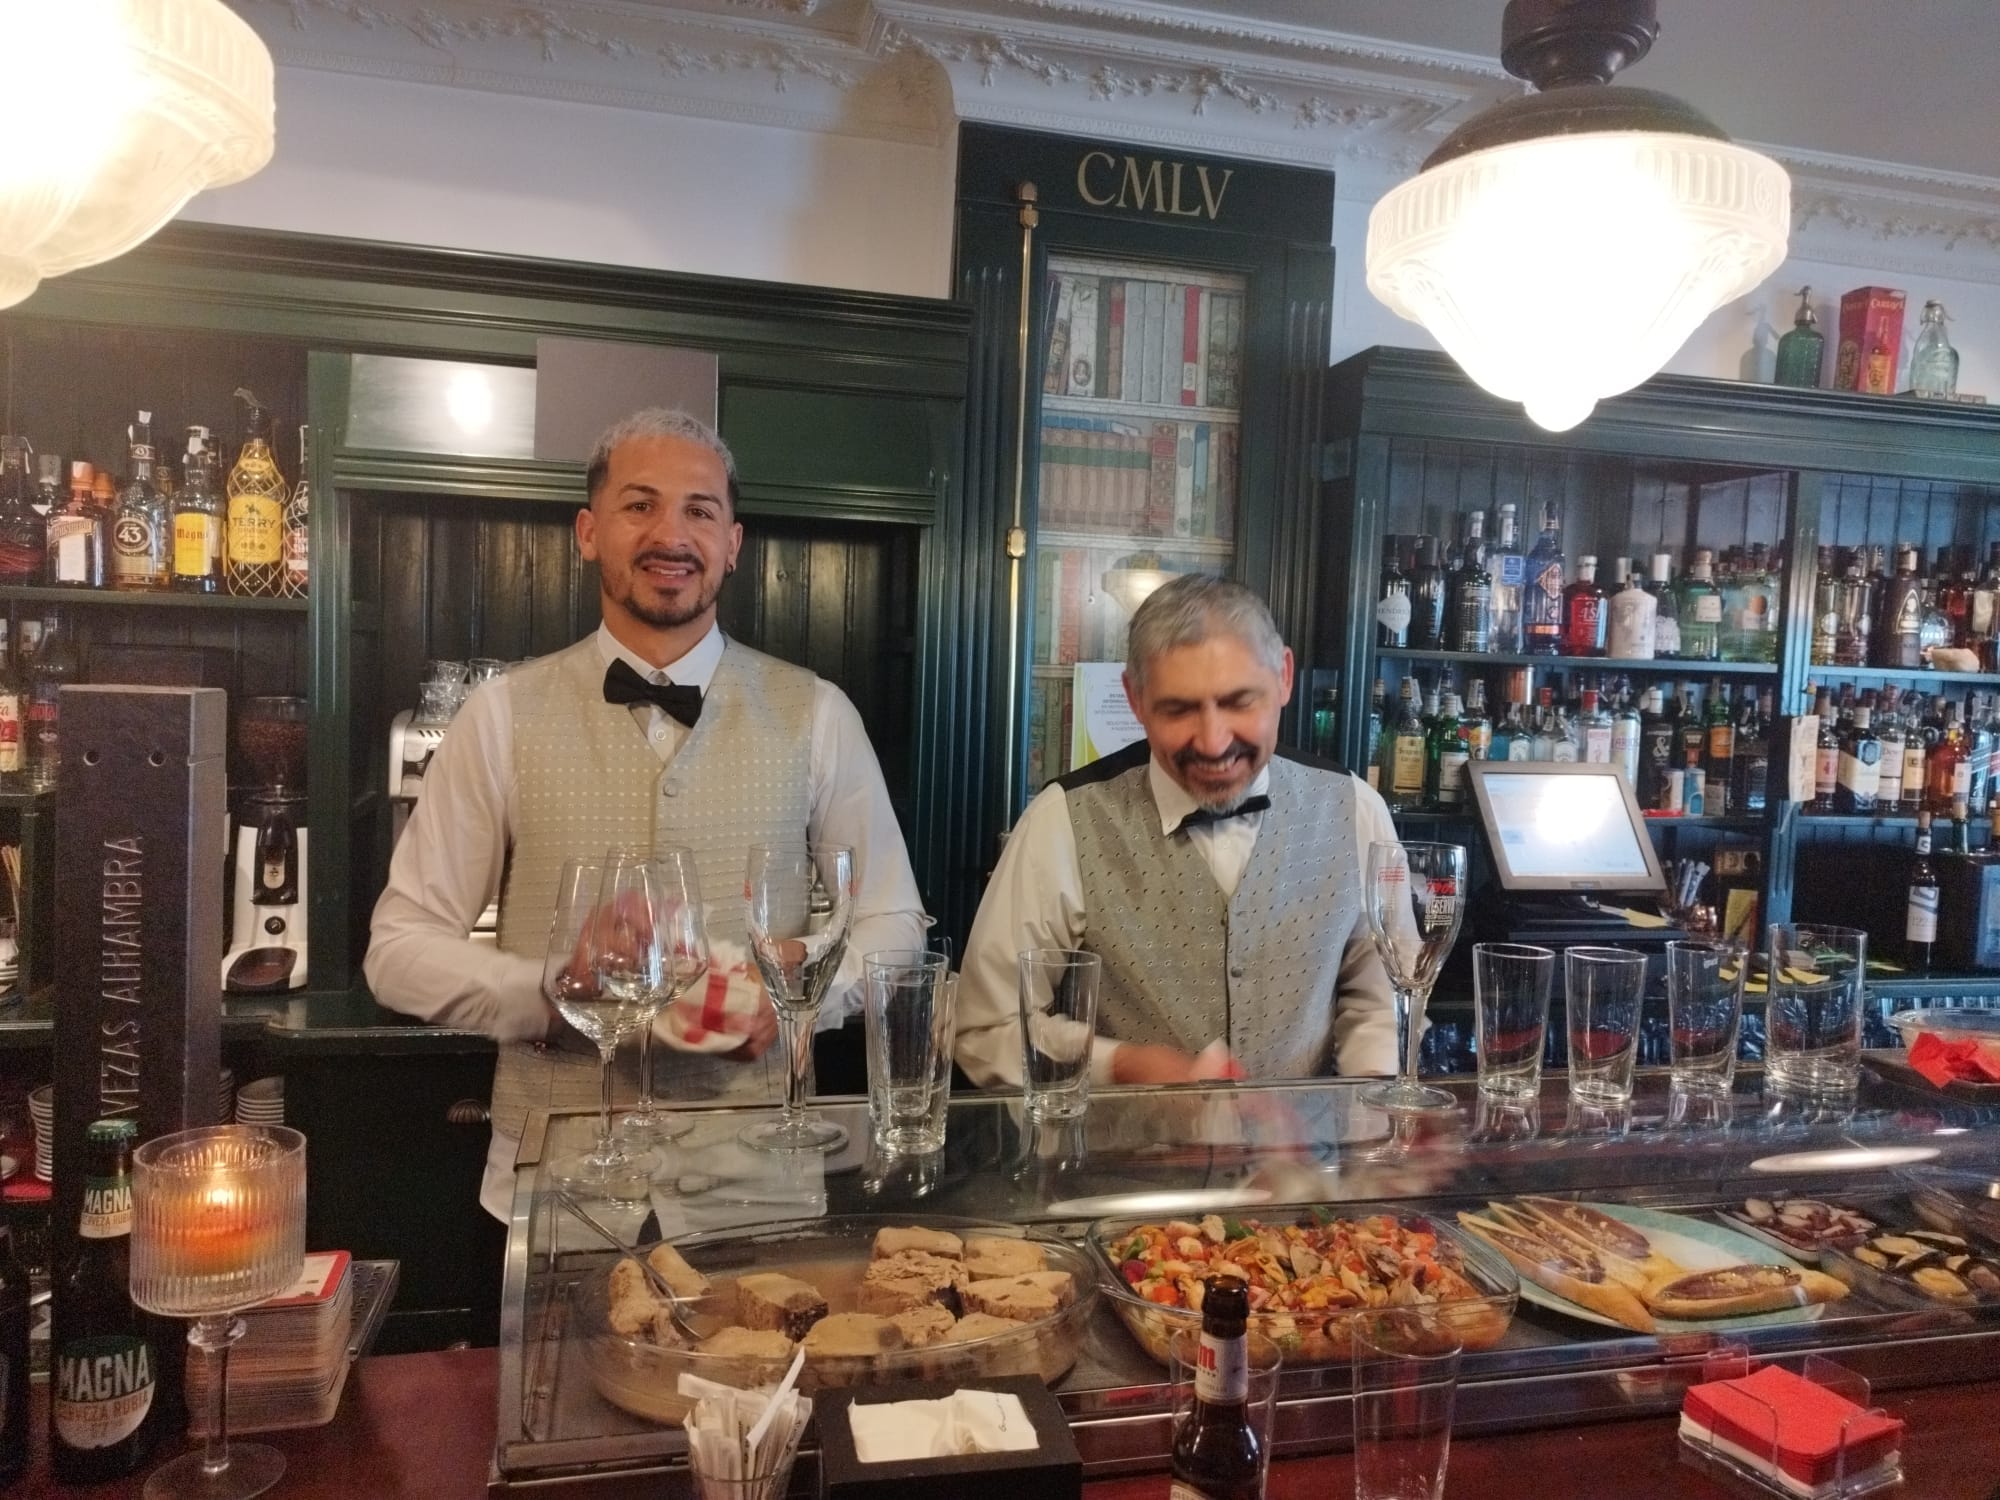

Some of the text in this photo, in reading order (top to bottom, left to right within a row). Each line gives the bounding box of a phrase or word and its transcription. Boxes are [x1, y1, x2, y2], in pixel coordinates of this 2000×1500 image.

[1077, 152, 1234, 220] CMLV
[118, 526, 142, 543] 43
[233, 517, 276, 529] TERRY
[102, 836, 143, 1004] ALHAMBRA
[83, 1186, 133, 1214] MAGNA
[59, 1344, 150, 1402] MAGNA
